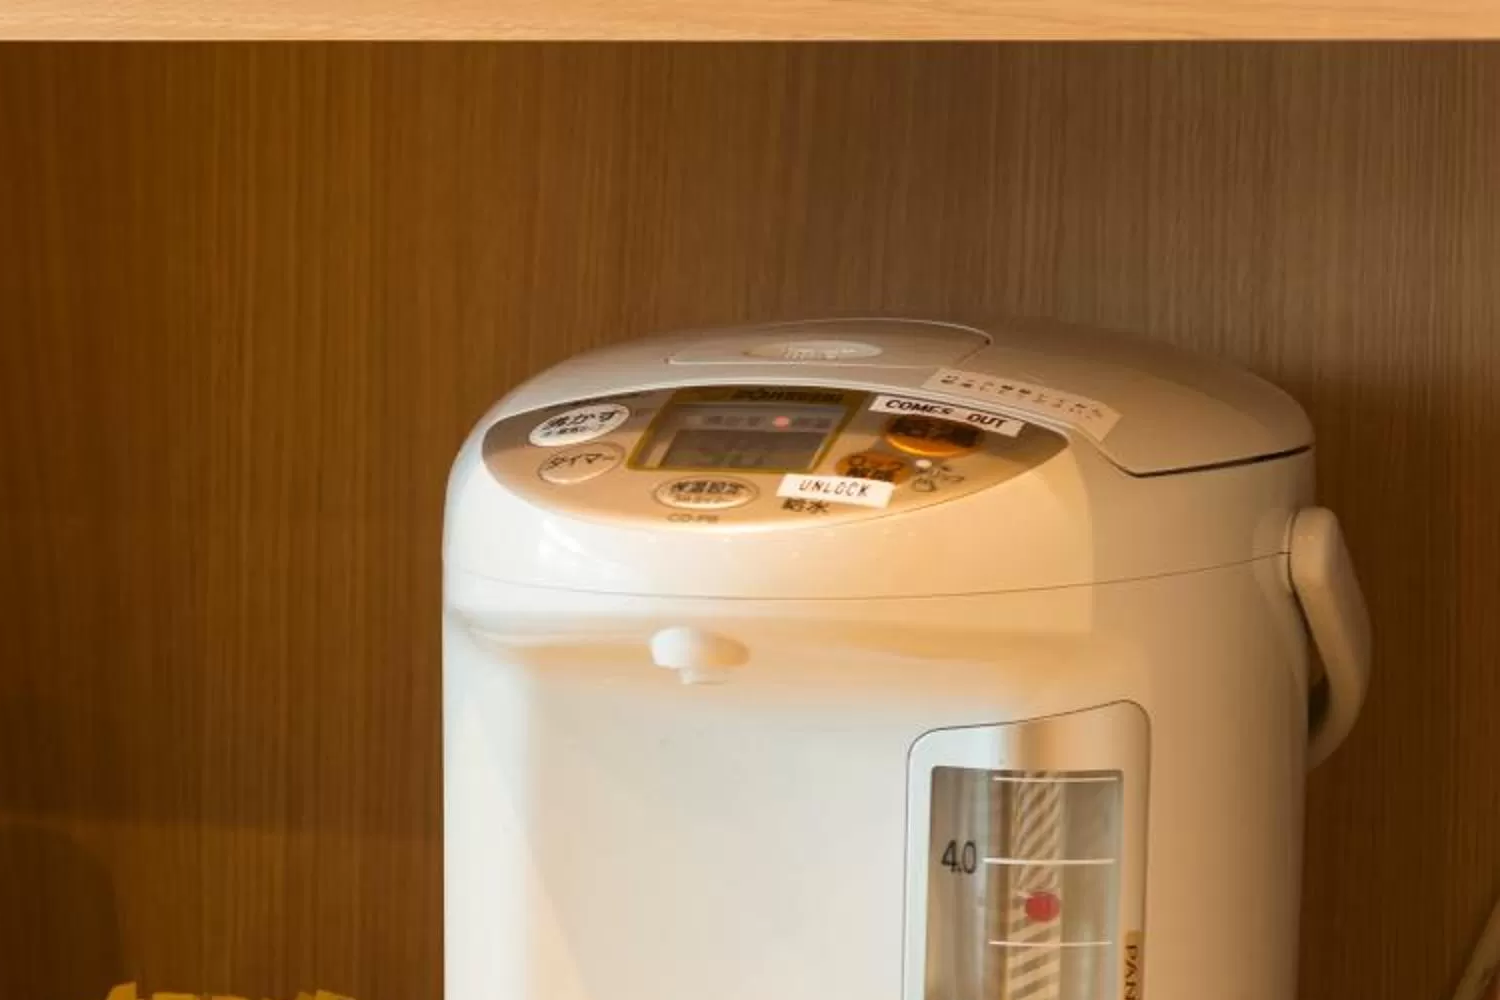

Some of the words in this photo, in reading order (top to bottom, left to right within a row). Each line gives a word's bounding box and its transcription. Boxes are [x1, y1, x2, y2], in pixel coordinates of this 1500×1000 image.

[885, 399, 954, 415] COMES
[967, 413, 1007, 429] OUT
[799, 479, 872, 497] UNLOCK
[941, 839, 977, 874] 4.0
